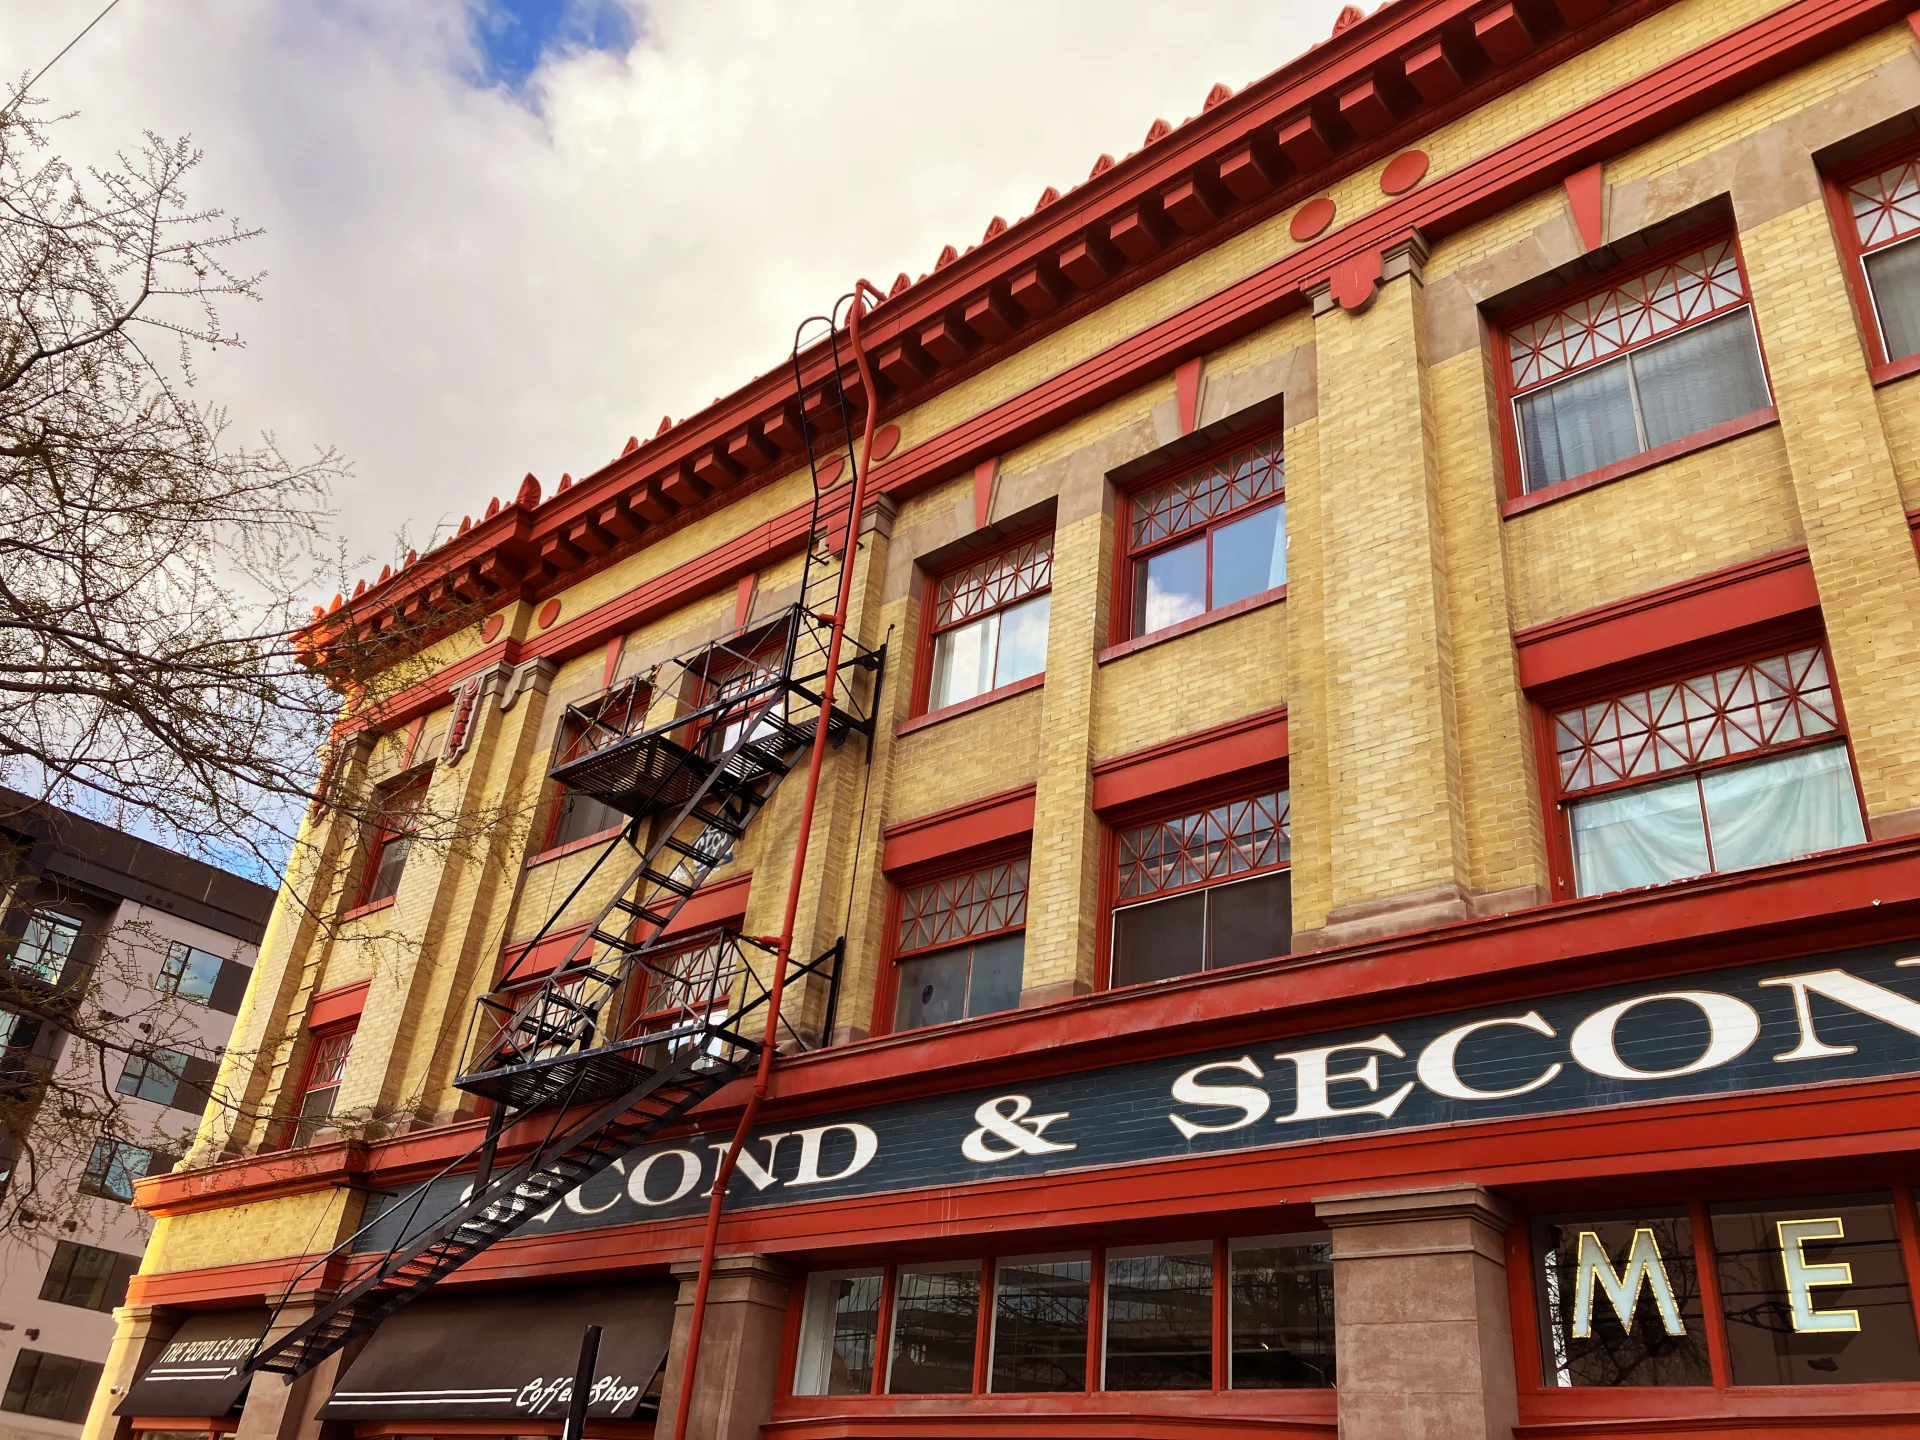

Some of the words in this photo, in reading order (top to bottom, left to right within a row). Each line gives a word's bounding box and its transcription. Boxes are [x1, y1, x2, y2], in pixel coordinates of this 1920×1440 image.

[961, 1094, 1077, 1163] &
[159, 1342, 189, 1363] THE
[178, 1336, 234, 1362] PEOPLE'S
[516, 1377, 573, 1414] Coffe
[588, 1375, 639, 1413] Shop
